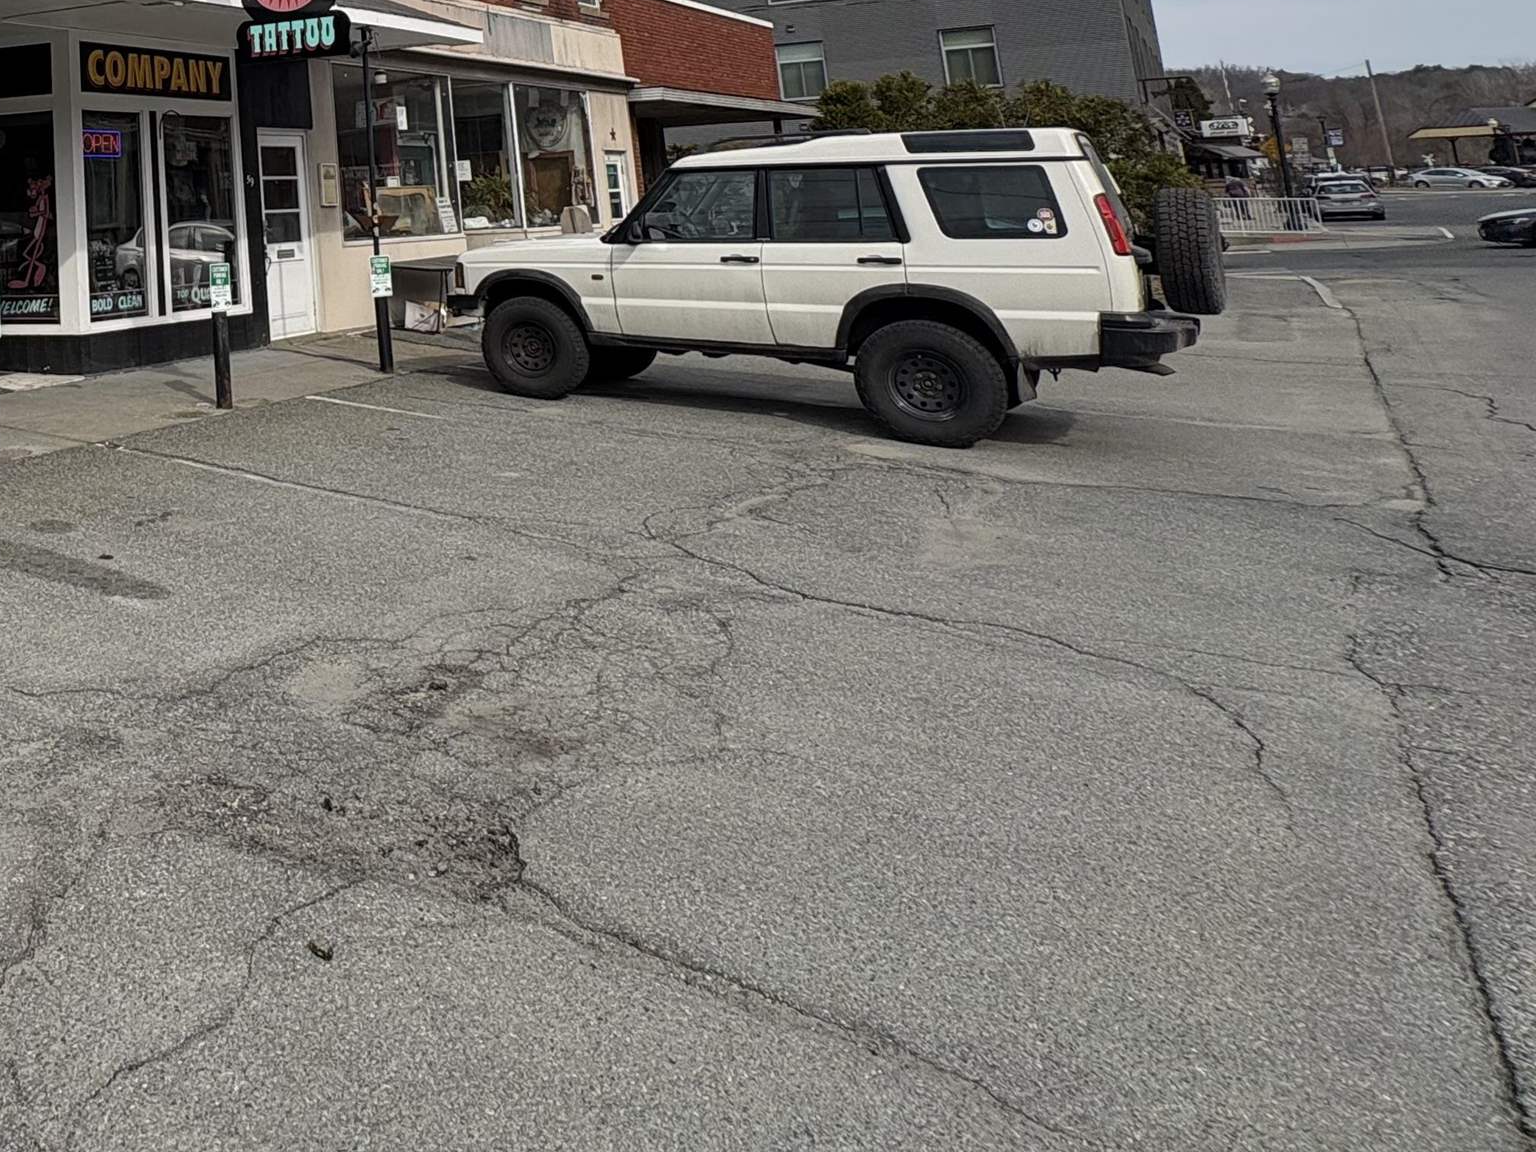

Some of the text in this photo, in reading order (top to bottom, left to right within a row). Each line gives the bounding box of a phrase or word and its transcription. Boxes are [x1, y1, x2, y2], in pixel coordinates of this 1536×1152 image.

[248, 16, 335, 56] TATTOO
[87, 48, 224, 95] COMPANY
[83, 132, 120, 154] OPEN
[91, 294, 143, 312] BOLD CLEAN
